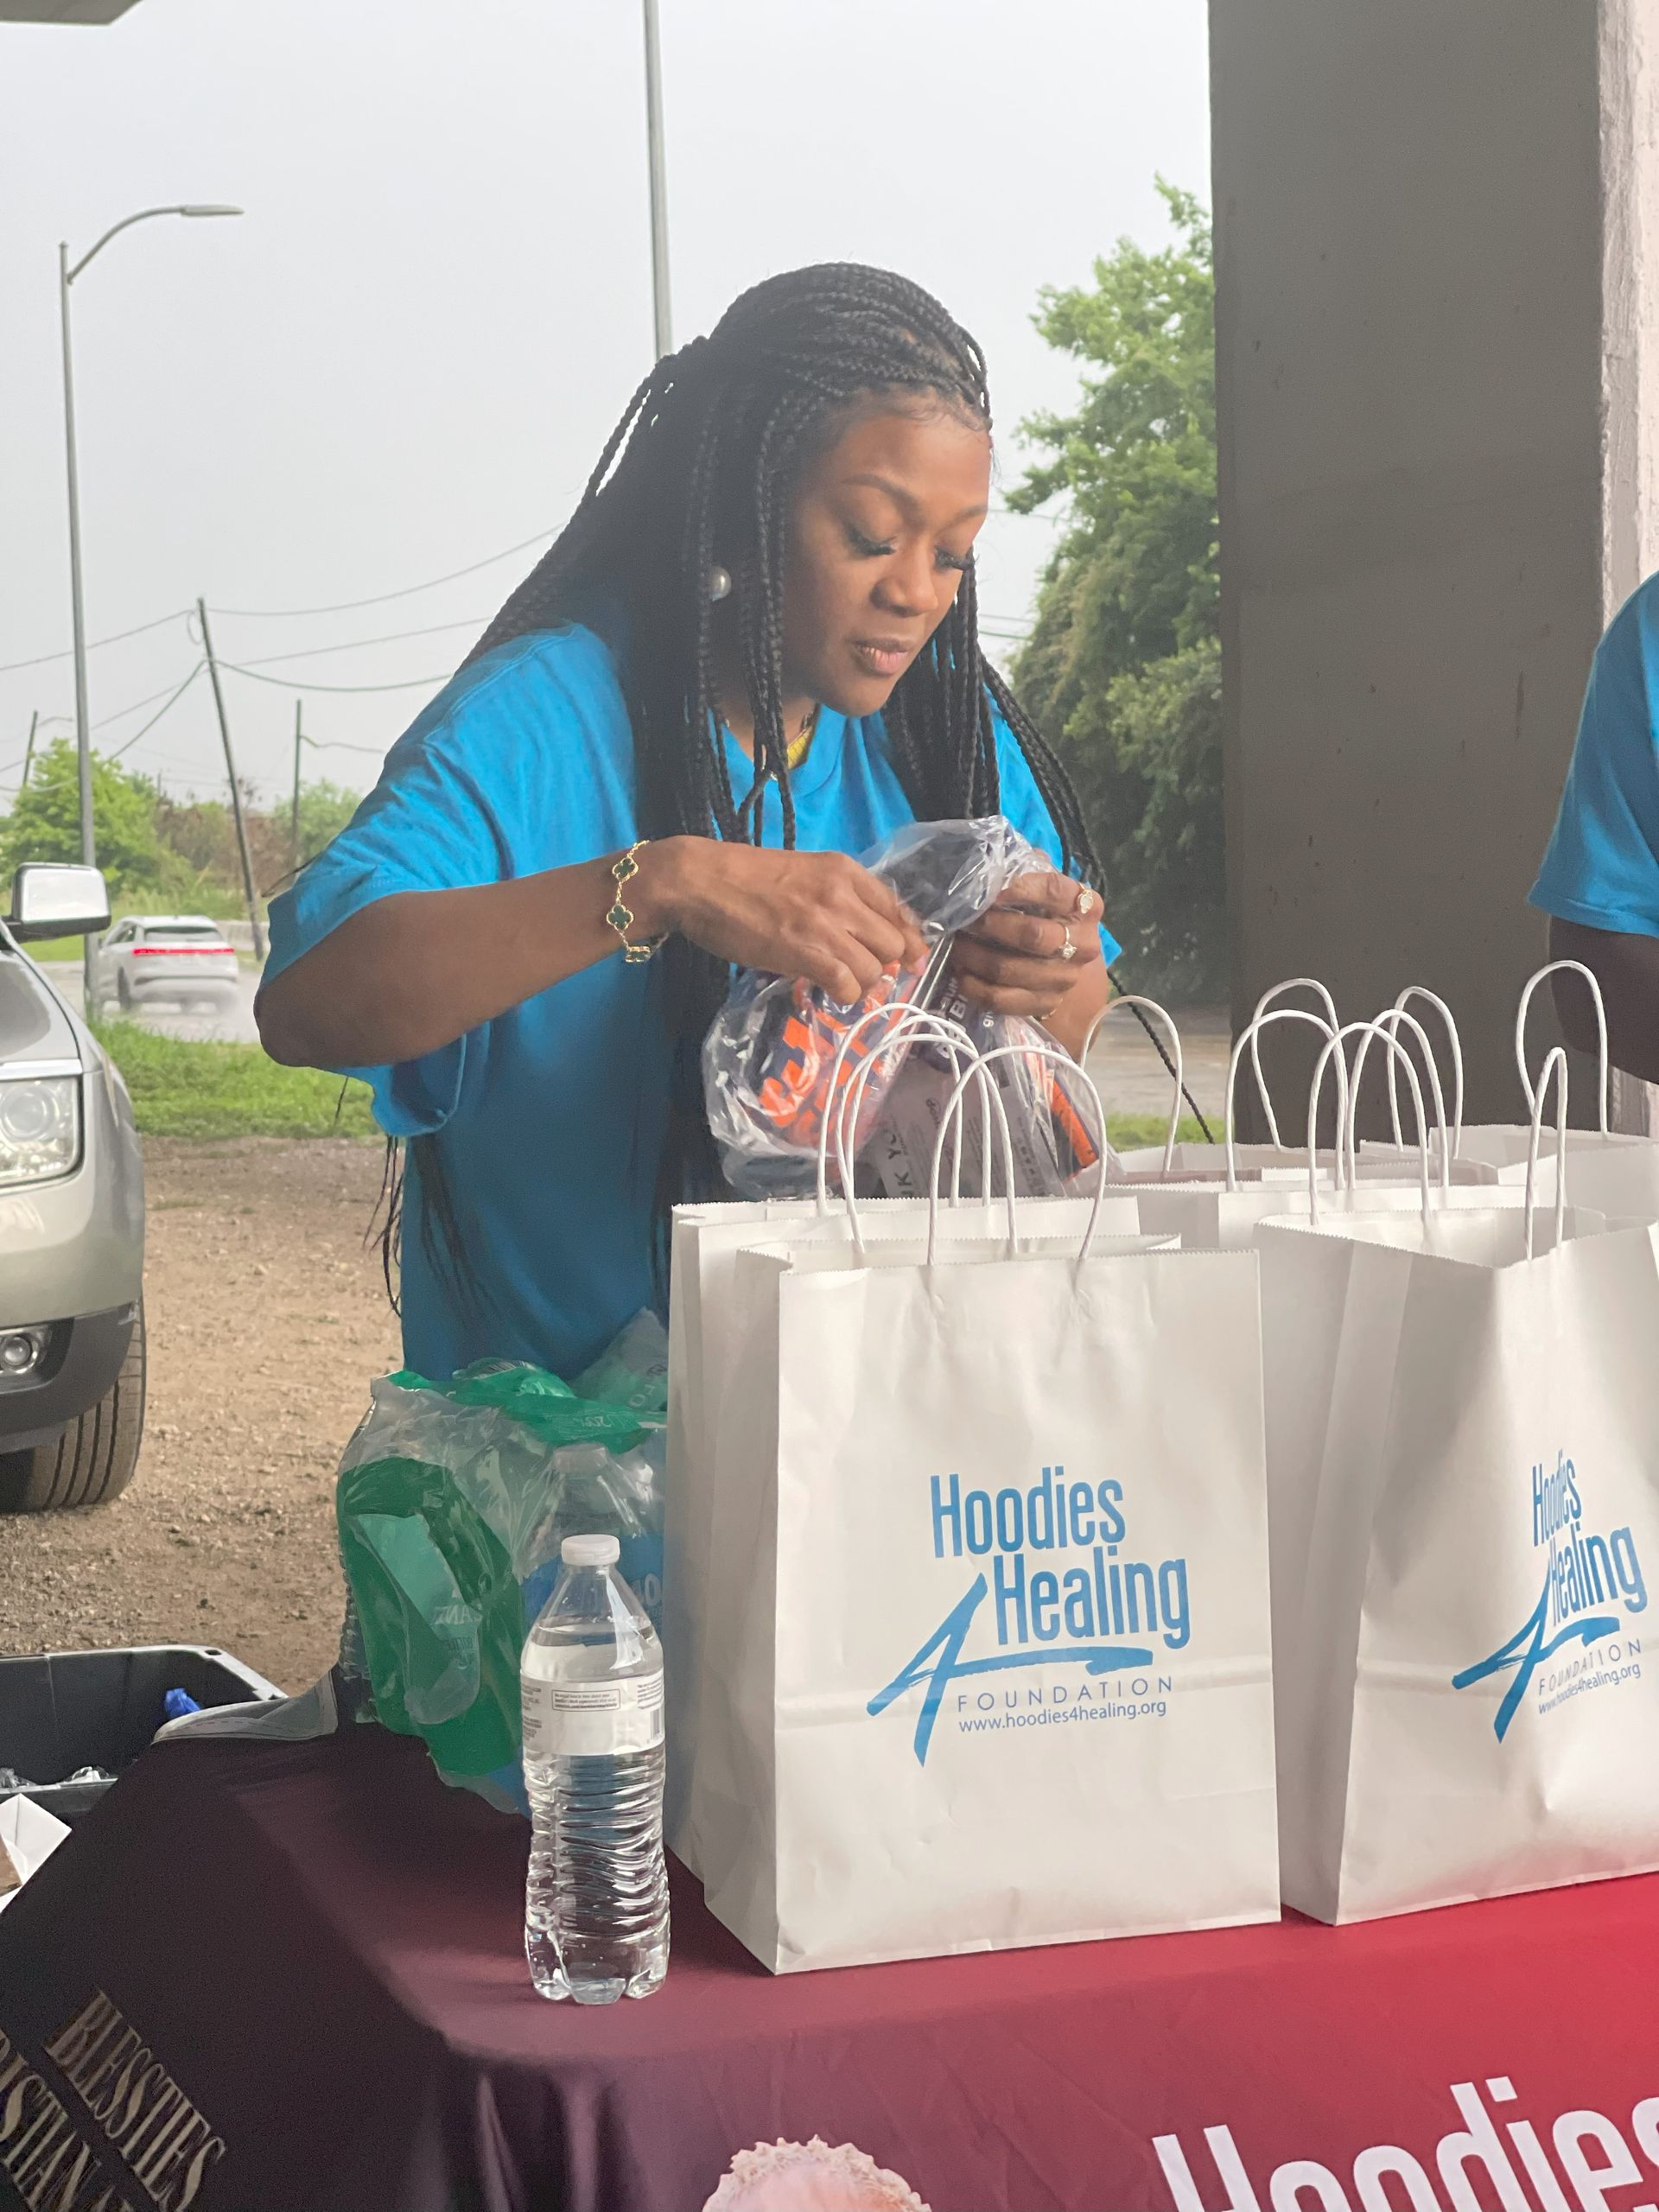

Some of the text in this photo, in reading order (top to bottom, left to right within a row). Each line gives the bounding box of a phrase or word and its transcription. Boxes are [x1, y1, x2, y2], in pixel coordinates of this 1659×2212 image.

[930, 1465, 1126, 1558] Hoodies
[1532, 1449, 1582, 1547] Hoodies
[993, 1545, 1191, 1649] Healing
[1549, 1521, 1648, 1627] Healing
[957, 1676, 1173, 1713] FOUNDATION
[1538, 1662, 1642, 1715] www.hoodies4healing.org
[1539, 1638, 1642, 1696] FOUNDATION
[959, 1700, 1167, 1733] www.hoodies4healing.org
